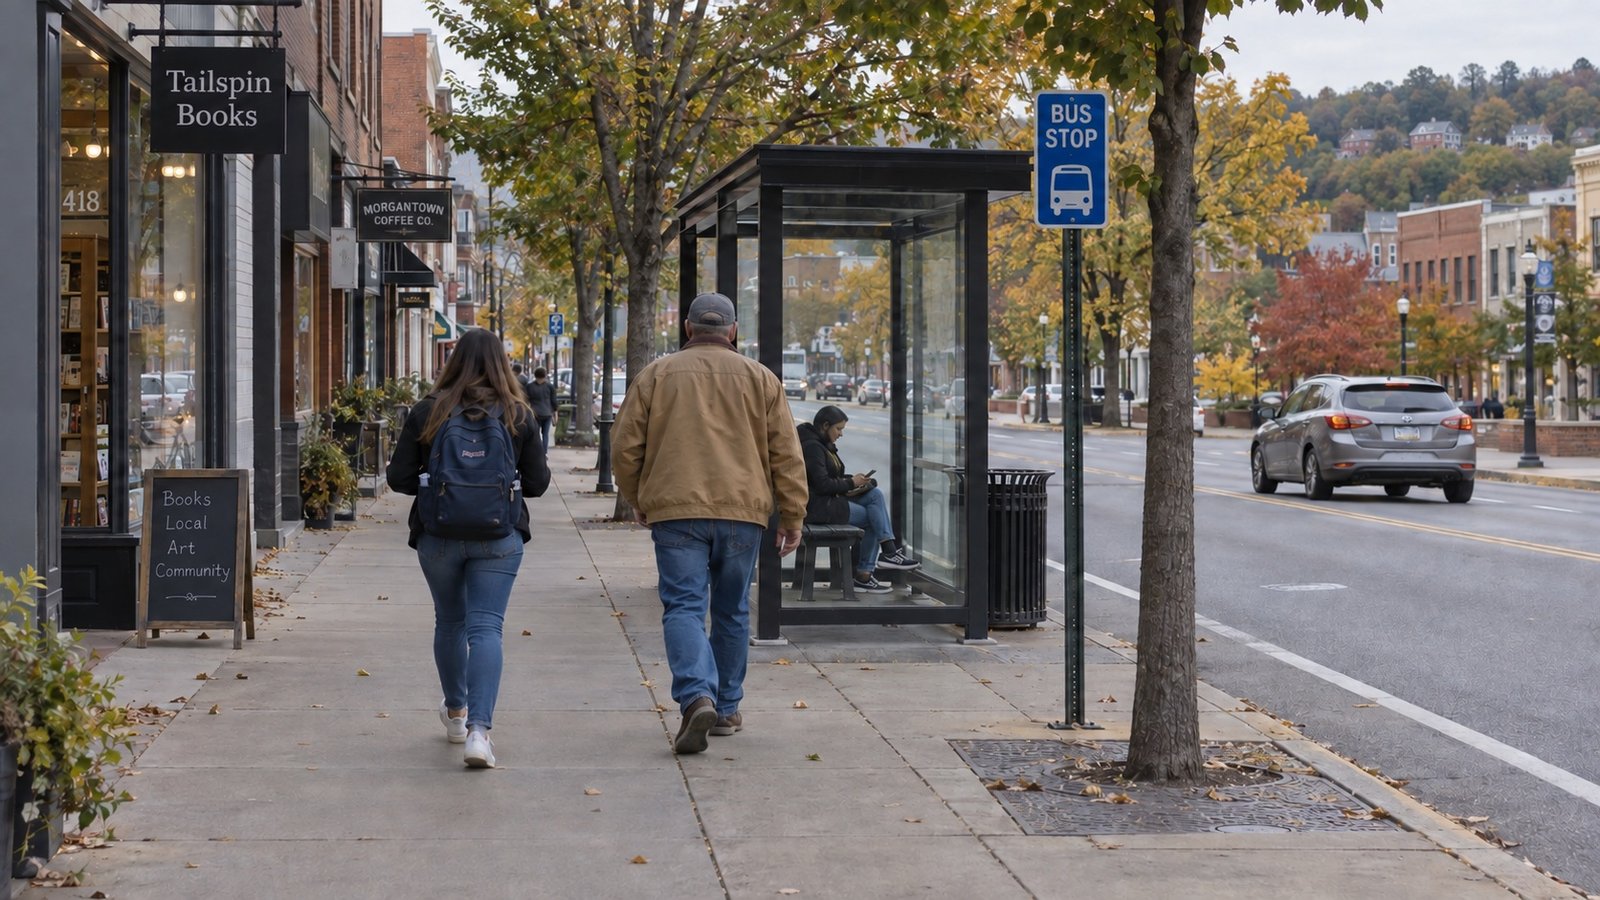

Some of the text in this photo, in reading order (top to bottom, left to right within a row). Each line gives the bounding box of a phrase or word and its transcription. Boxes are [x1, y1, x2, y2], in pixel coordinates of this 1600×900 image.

[166, 70, 272, 100] Tailspin
[176, 103, 258, 127] Books
[1051, 103, 1092, 124] BUS
[1045, 128, 1098, 148] STOP
[62, 189, 100, 213] 418
[363, 201, 445, 216] MORGANTOWN
[374, 216, 434, 226] COFFEE CO.
[162, 490, 212, 507] Books
[165, 515, 208, 530] Local
[167, 539, 196, 555] Art
[155, 562, 231, 583] Community
